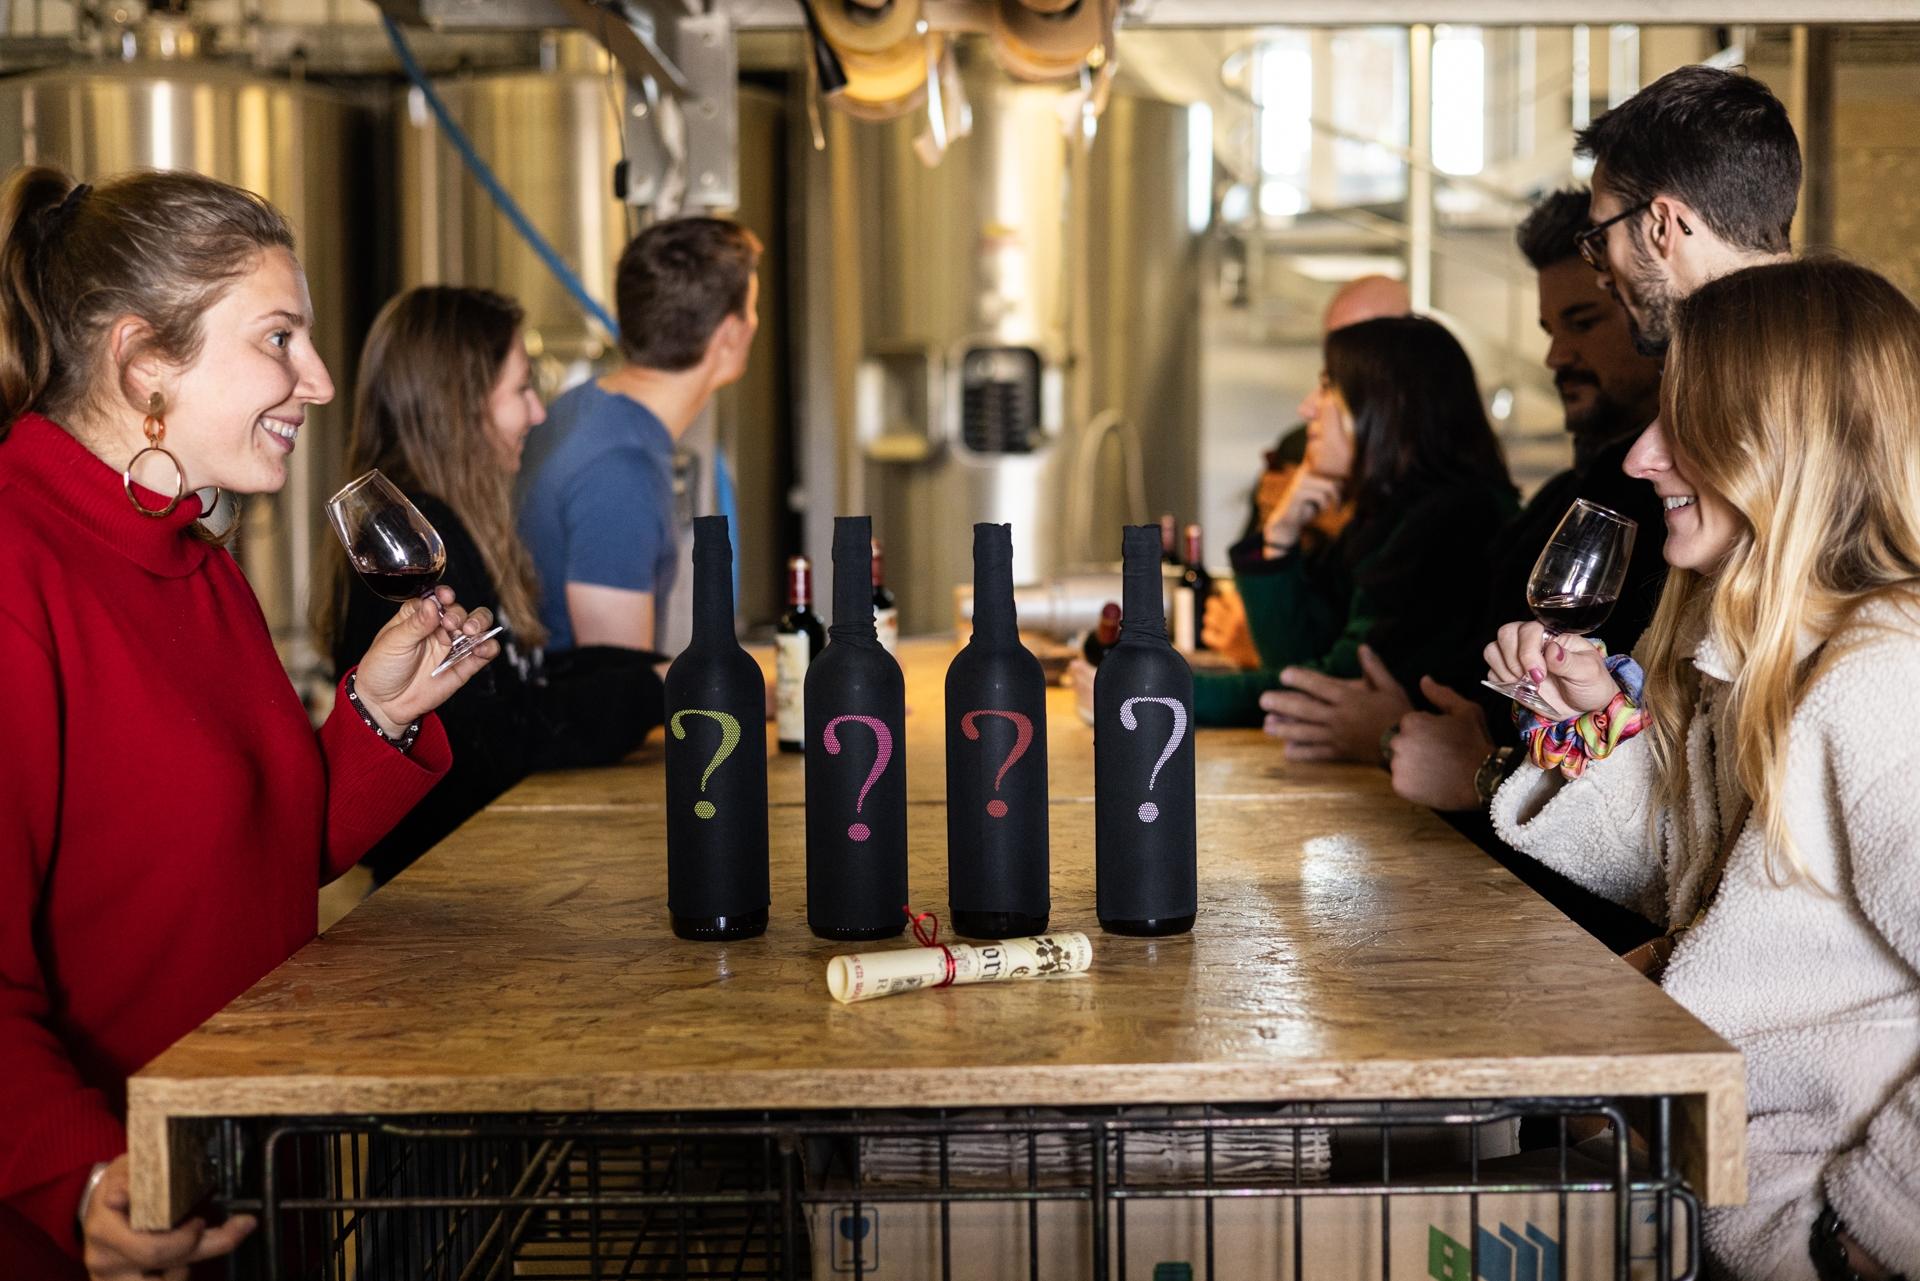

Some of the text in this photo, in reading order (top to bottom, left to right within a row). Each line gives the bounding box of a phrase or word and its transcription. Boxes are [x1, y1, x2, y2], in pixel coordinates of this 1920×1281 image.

[670, 709, 741, 820] ?
[823, 714, 893, 842] ?
[960, 709, 1033, 818] ?
[1119, 696, 1188, 823] ?
